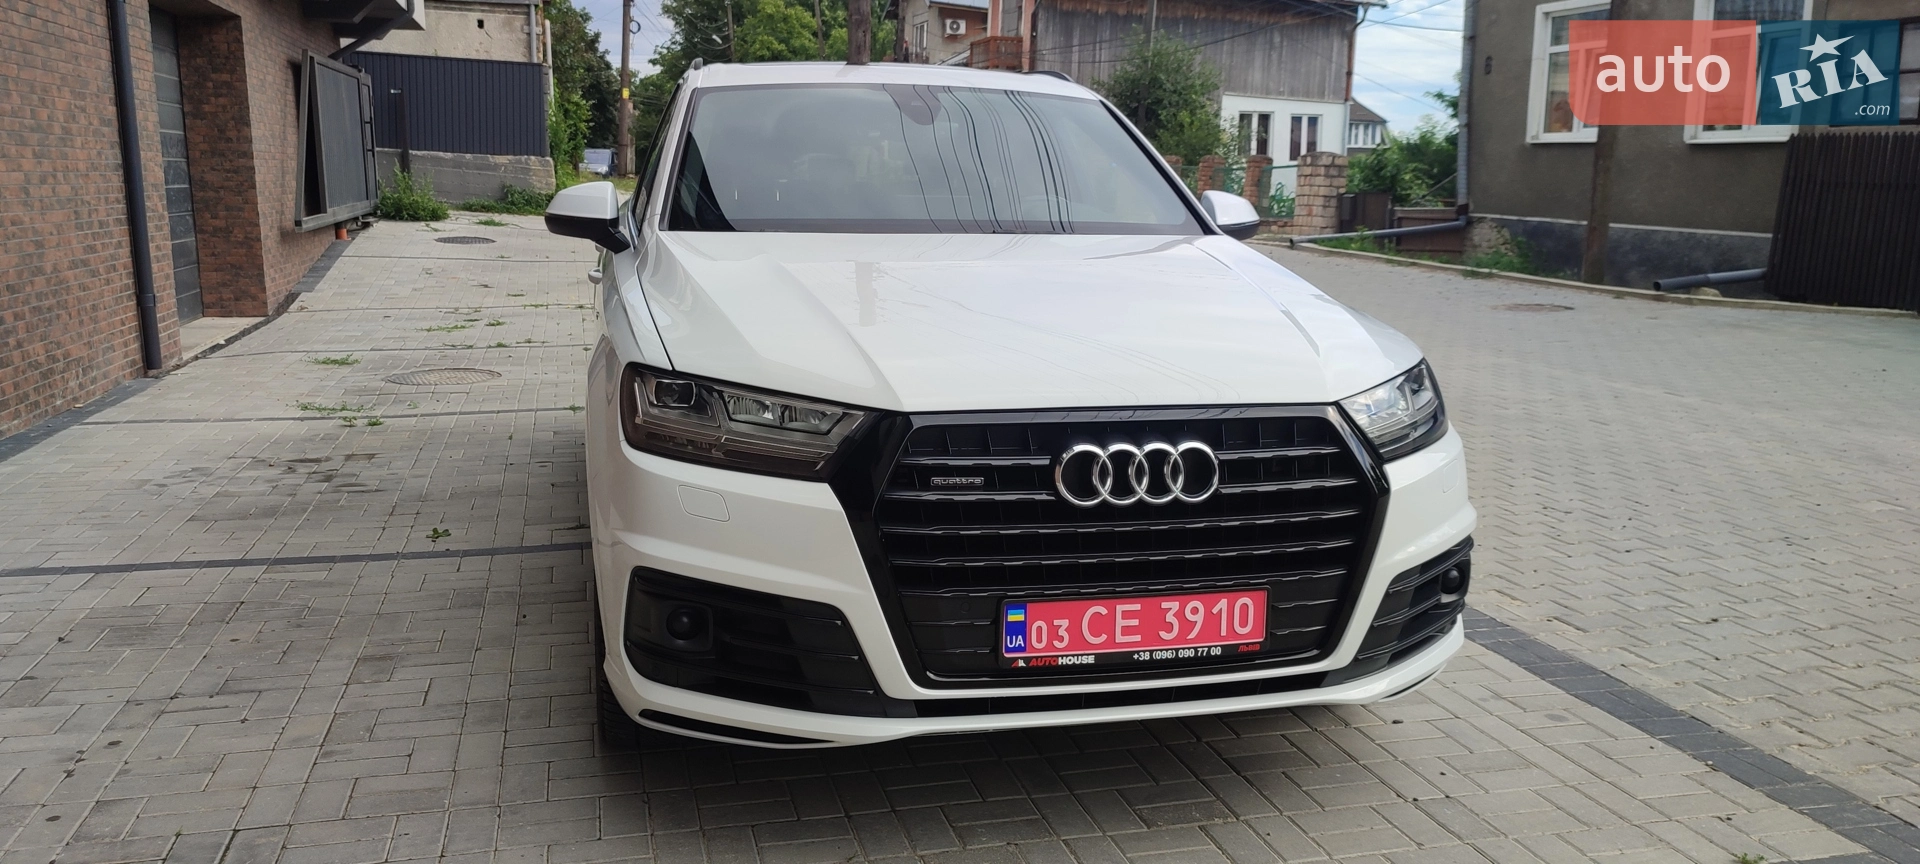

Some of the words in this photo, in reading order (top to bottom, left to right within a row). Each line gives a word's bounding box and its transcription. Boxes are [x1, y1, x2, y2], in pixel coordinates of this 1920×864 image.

[1031, 619, 1070, 650] 03
[1081, 604, 1141, 644] CE
[1158, 597, 1254, 640] 3910
[1007, 635, 1025, 648] UA
[1132, 651, 1150, 661] +38
[1152, 649, 1176, 660] (096)
[1178, 648, 1195, 658] 090
[1197, 647, 1209, 657] 77
[1210, 646, 1222, 656] 00
